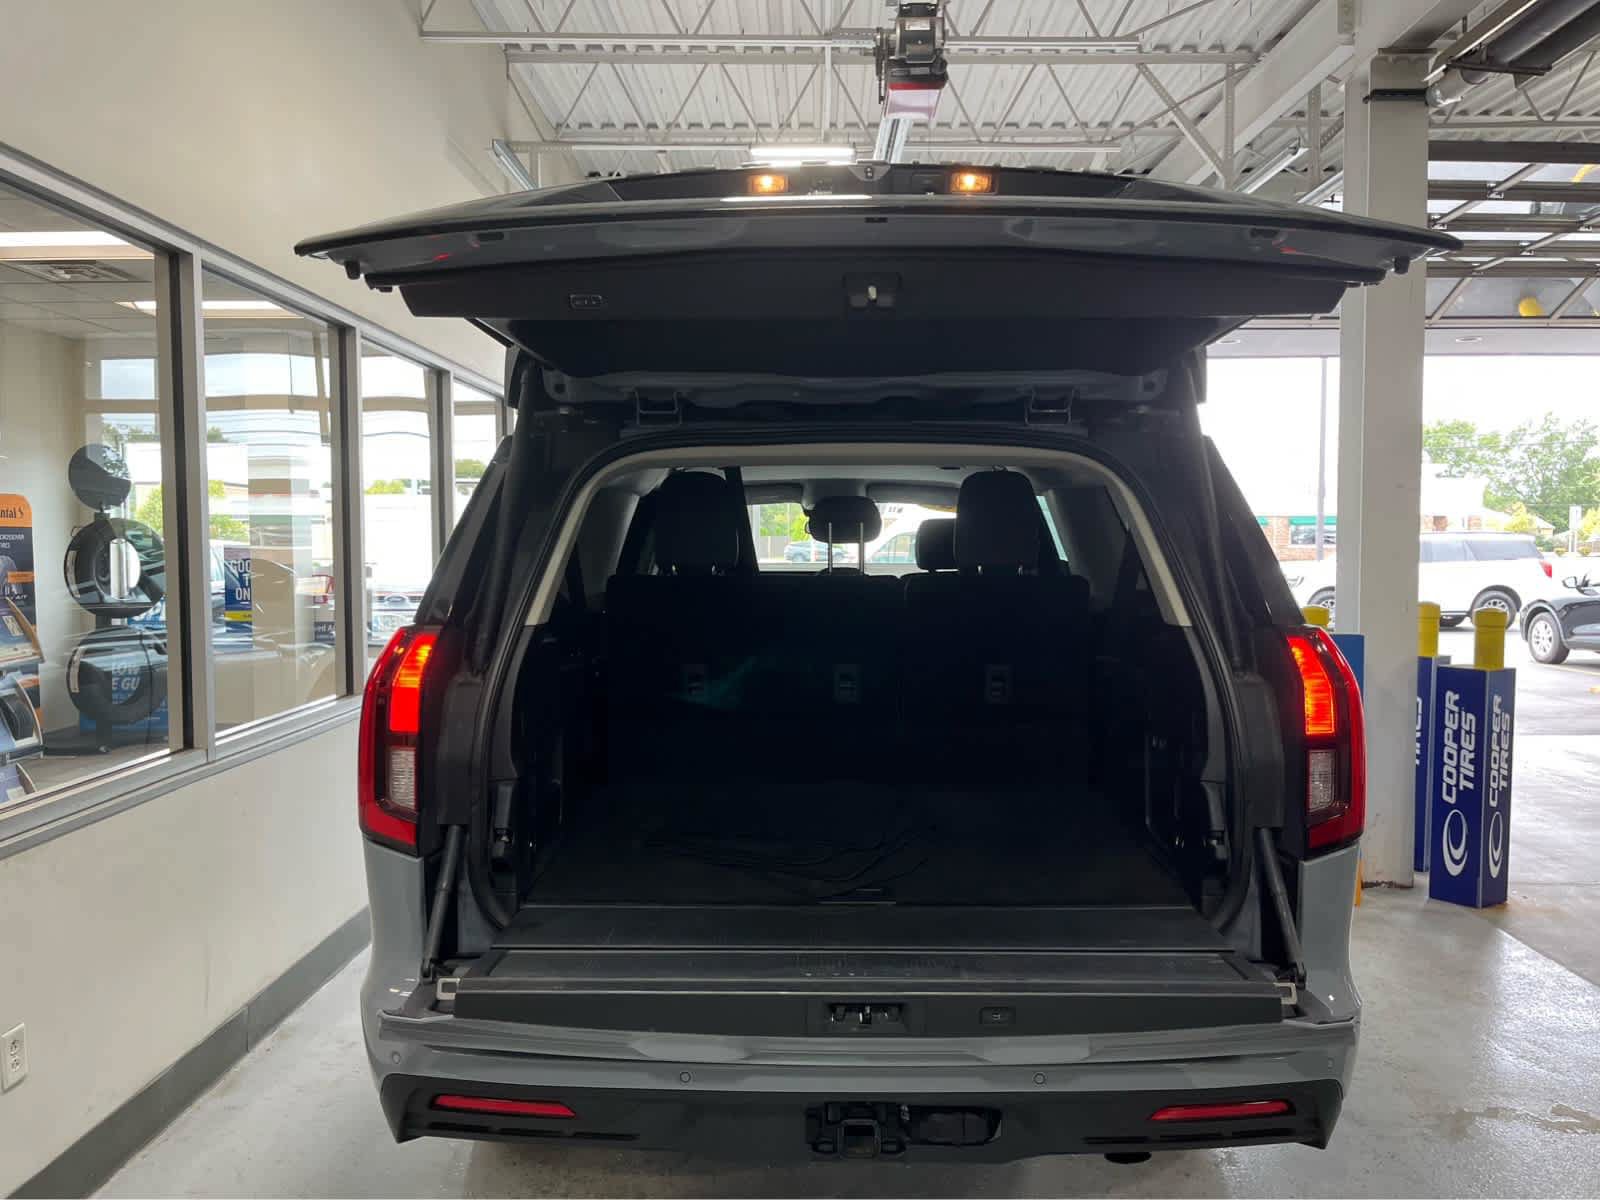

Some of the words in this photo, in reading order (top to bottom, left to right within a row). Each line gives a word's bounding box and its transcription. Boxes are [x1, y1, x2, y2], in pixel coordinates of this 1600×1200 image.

[1442, 690, 1460, 804] COOPER
[1459, 711, 1477, 791] TIRES
[1489, 695, 1502, 807] COOPER
[1499, 711, 1511, 791] TIRES
